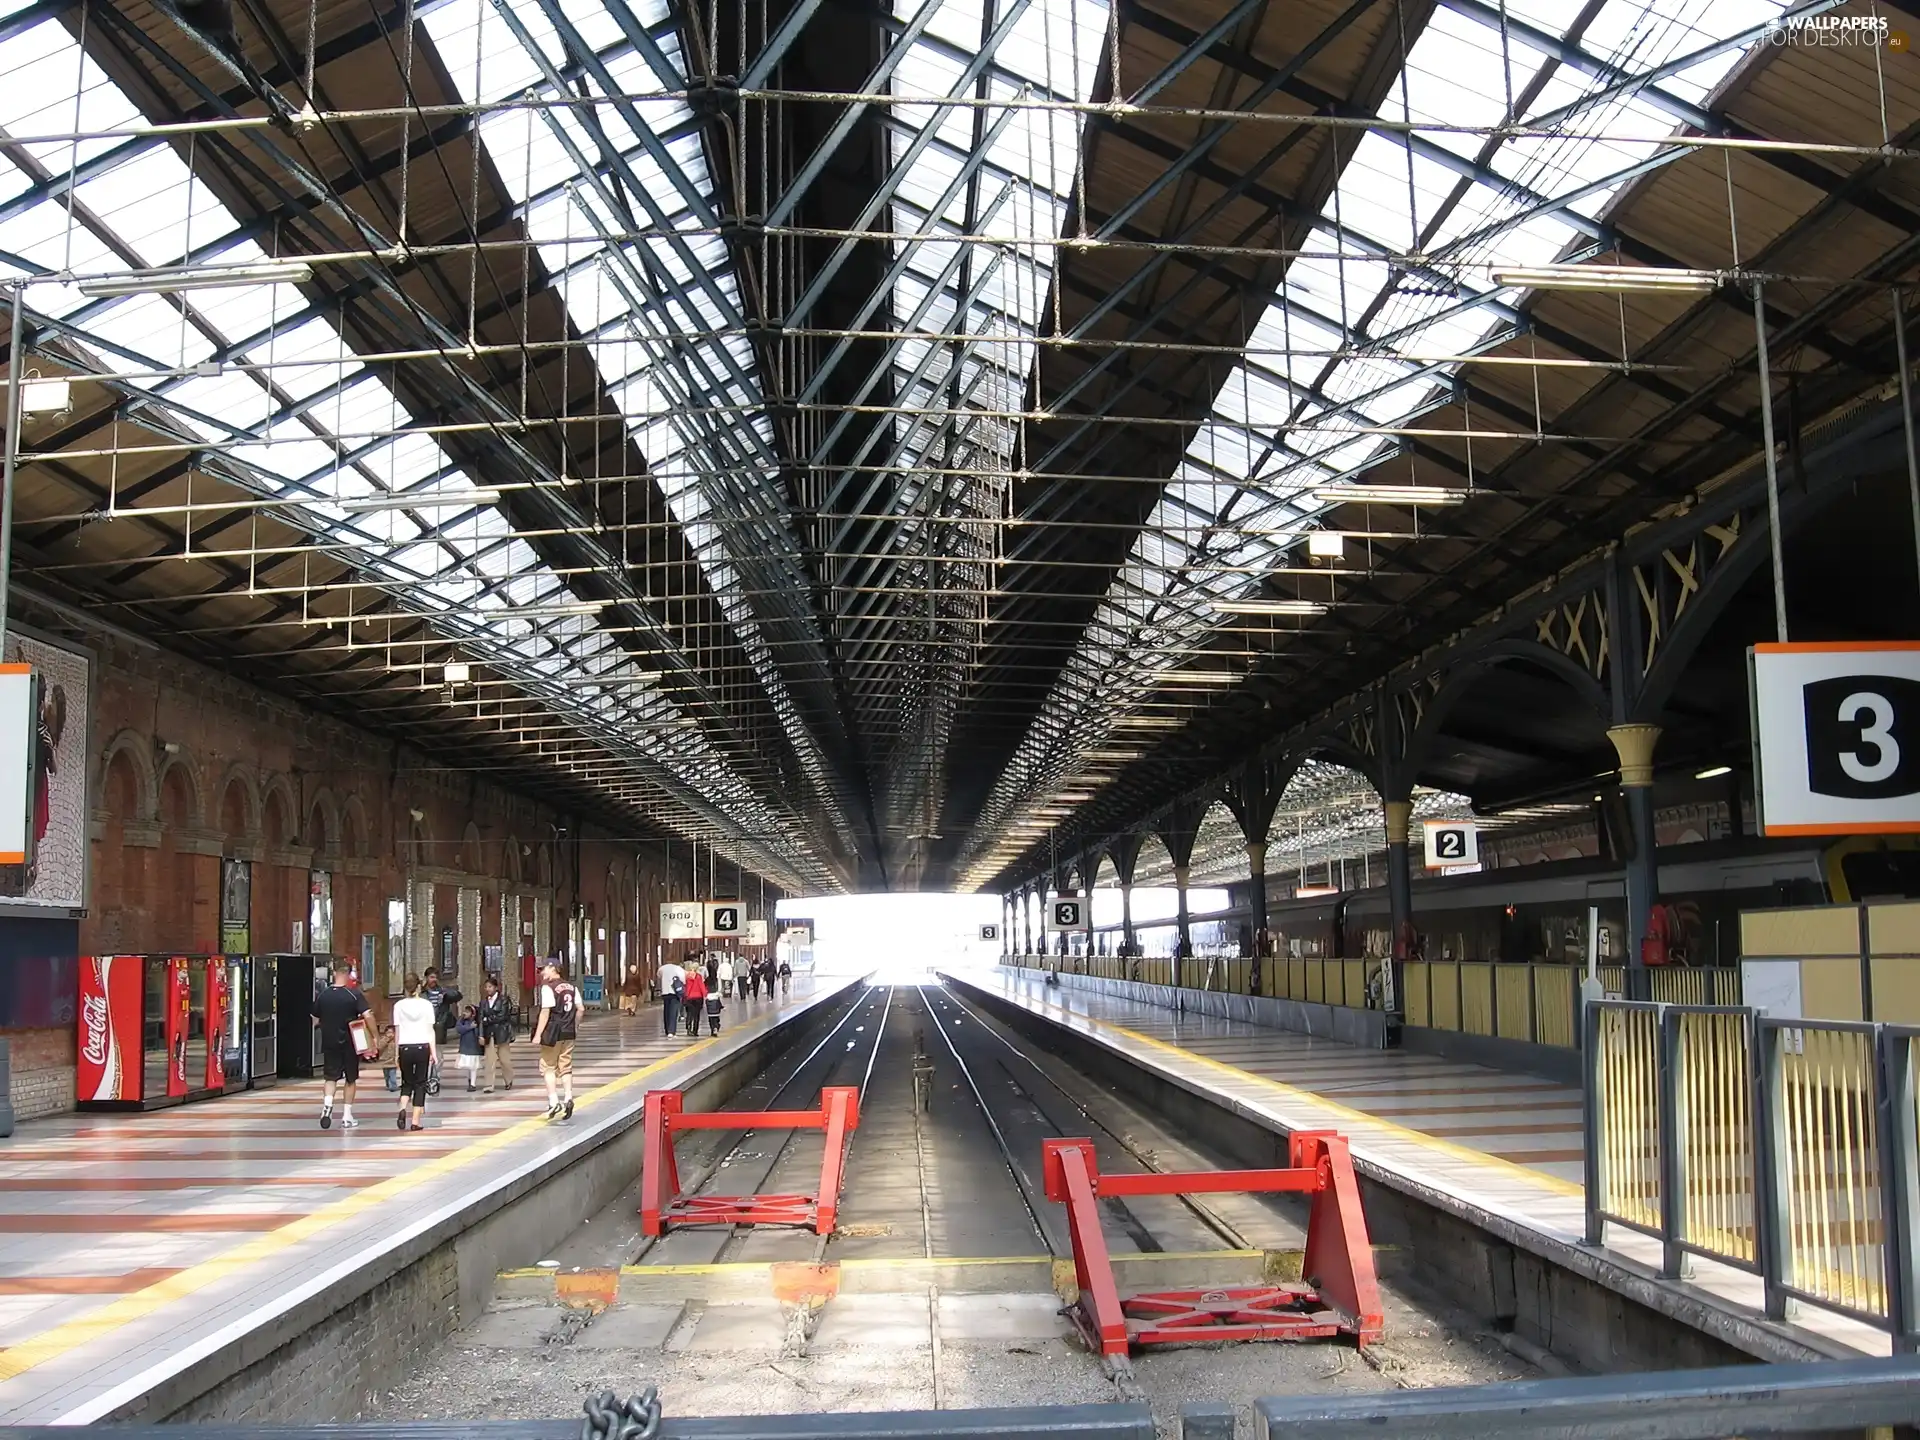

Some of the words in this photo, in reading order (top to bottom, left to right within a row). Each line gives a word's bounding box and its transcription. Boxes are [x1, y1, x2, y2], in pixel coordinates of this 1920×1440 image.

[1837, 691, 1900, 783] 3
[1442, 832, 1460, 856] 2
[718, 910, 733, 929] 4
[1060, 904, 1075, 924] 3
[984, 927, 993, 938] 3
[563, 993, 573, 1012] 3
